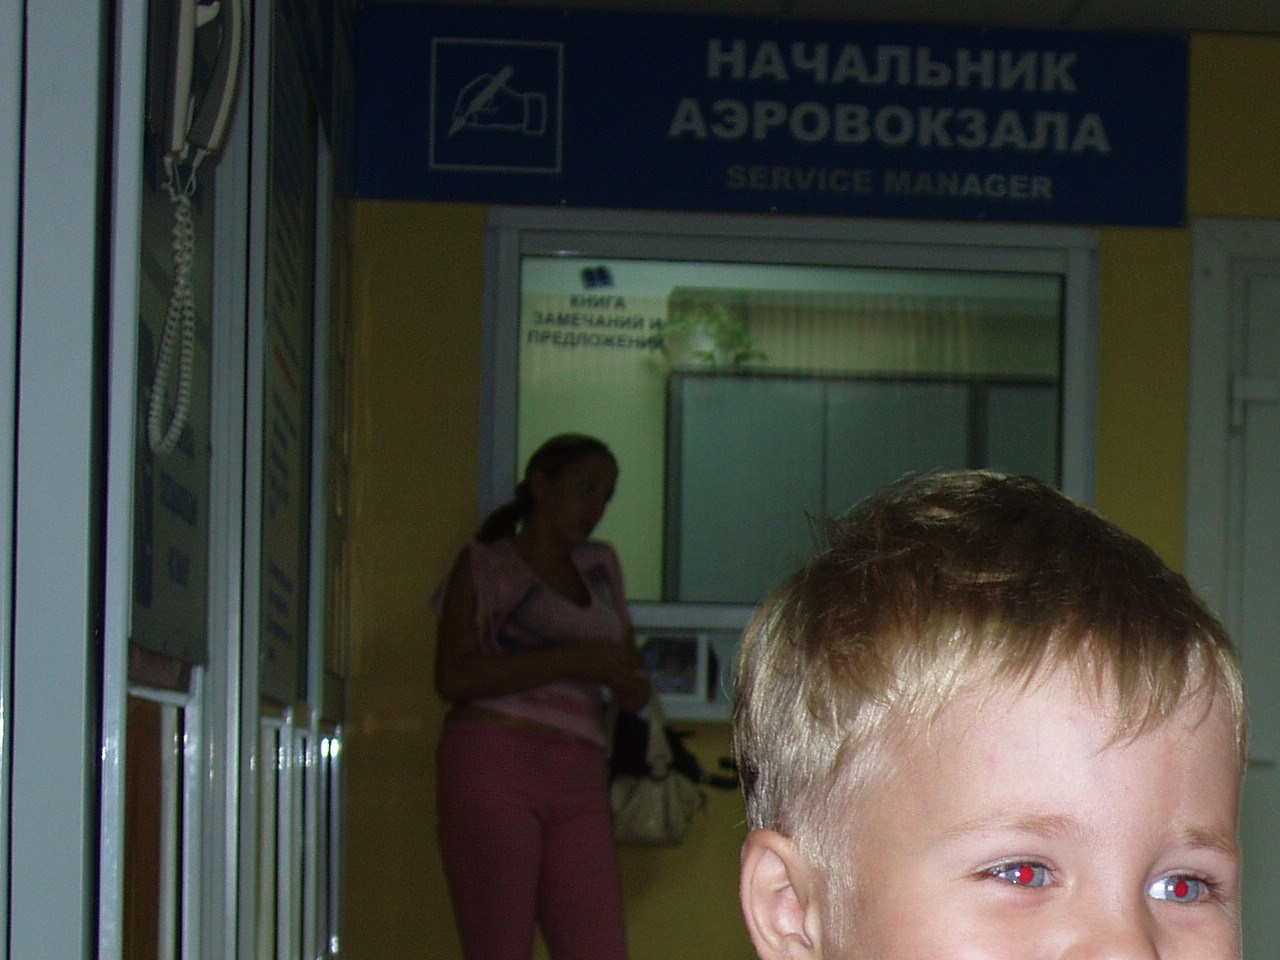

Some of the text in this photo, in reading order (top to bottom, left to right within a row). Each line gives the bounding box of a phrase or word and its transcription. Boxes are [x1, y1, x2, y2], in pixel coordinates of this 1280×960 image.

[706, 38, 1079, 92] НАЧАЛЬНИК
[667, 98, 1112, 154] АЭРОВОКЗАЛА
[727, 165, 1054, 199] SERVICE MANAGER
[570, 293, 626, 308] КНИГА
